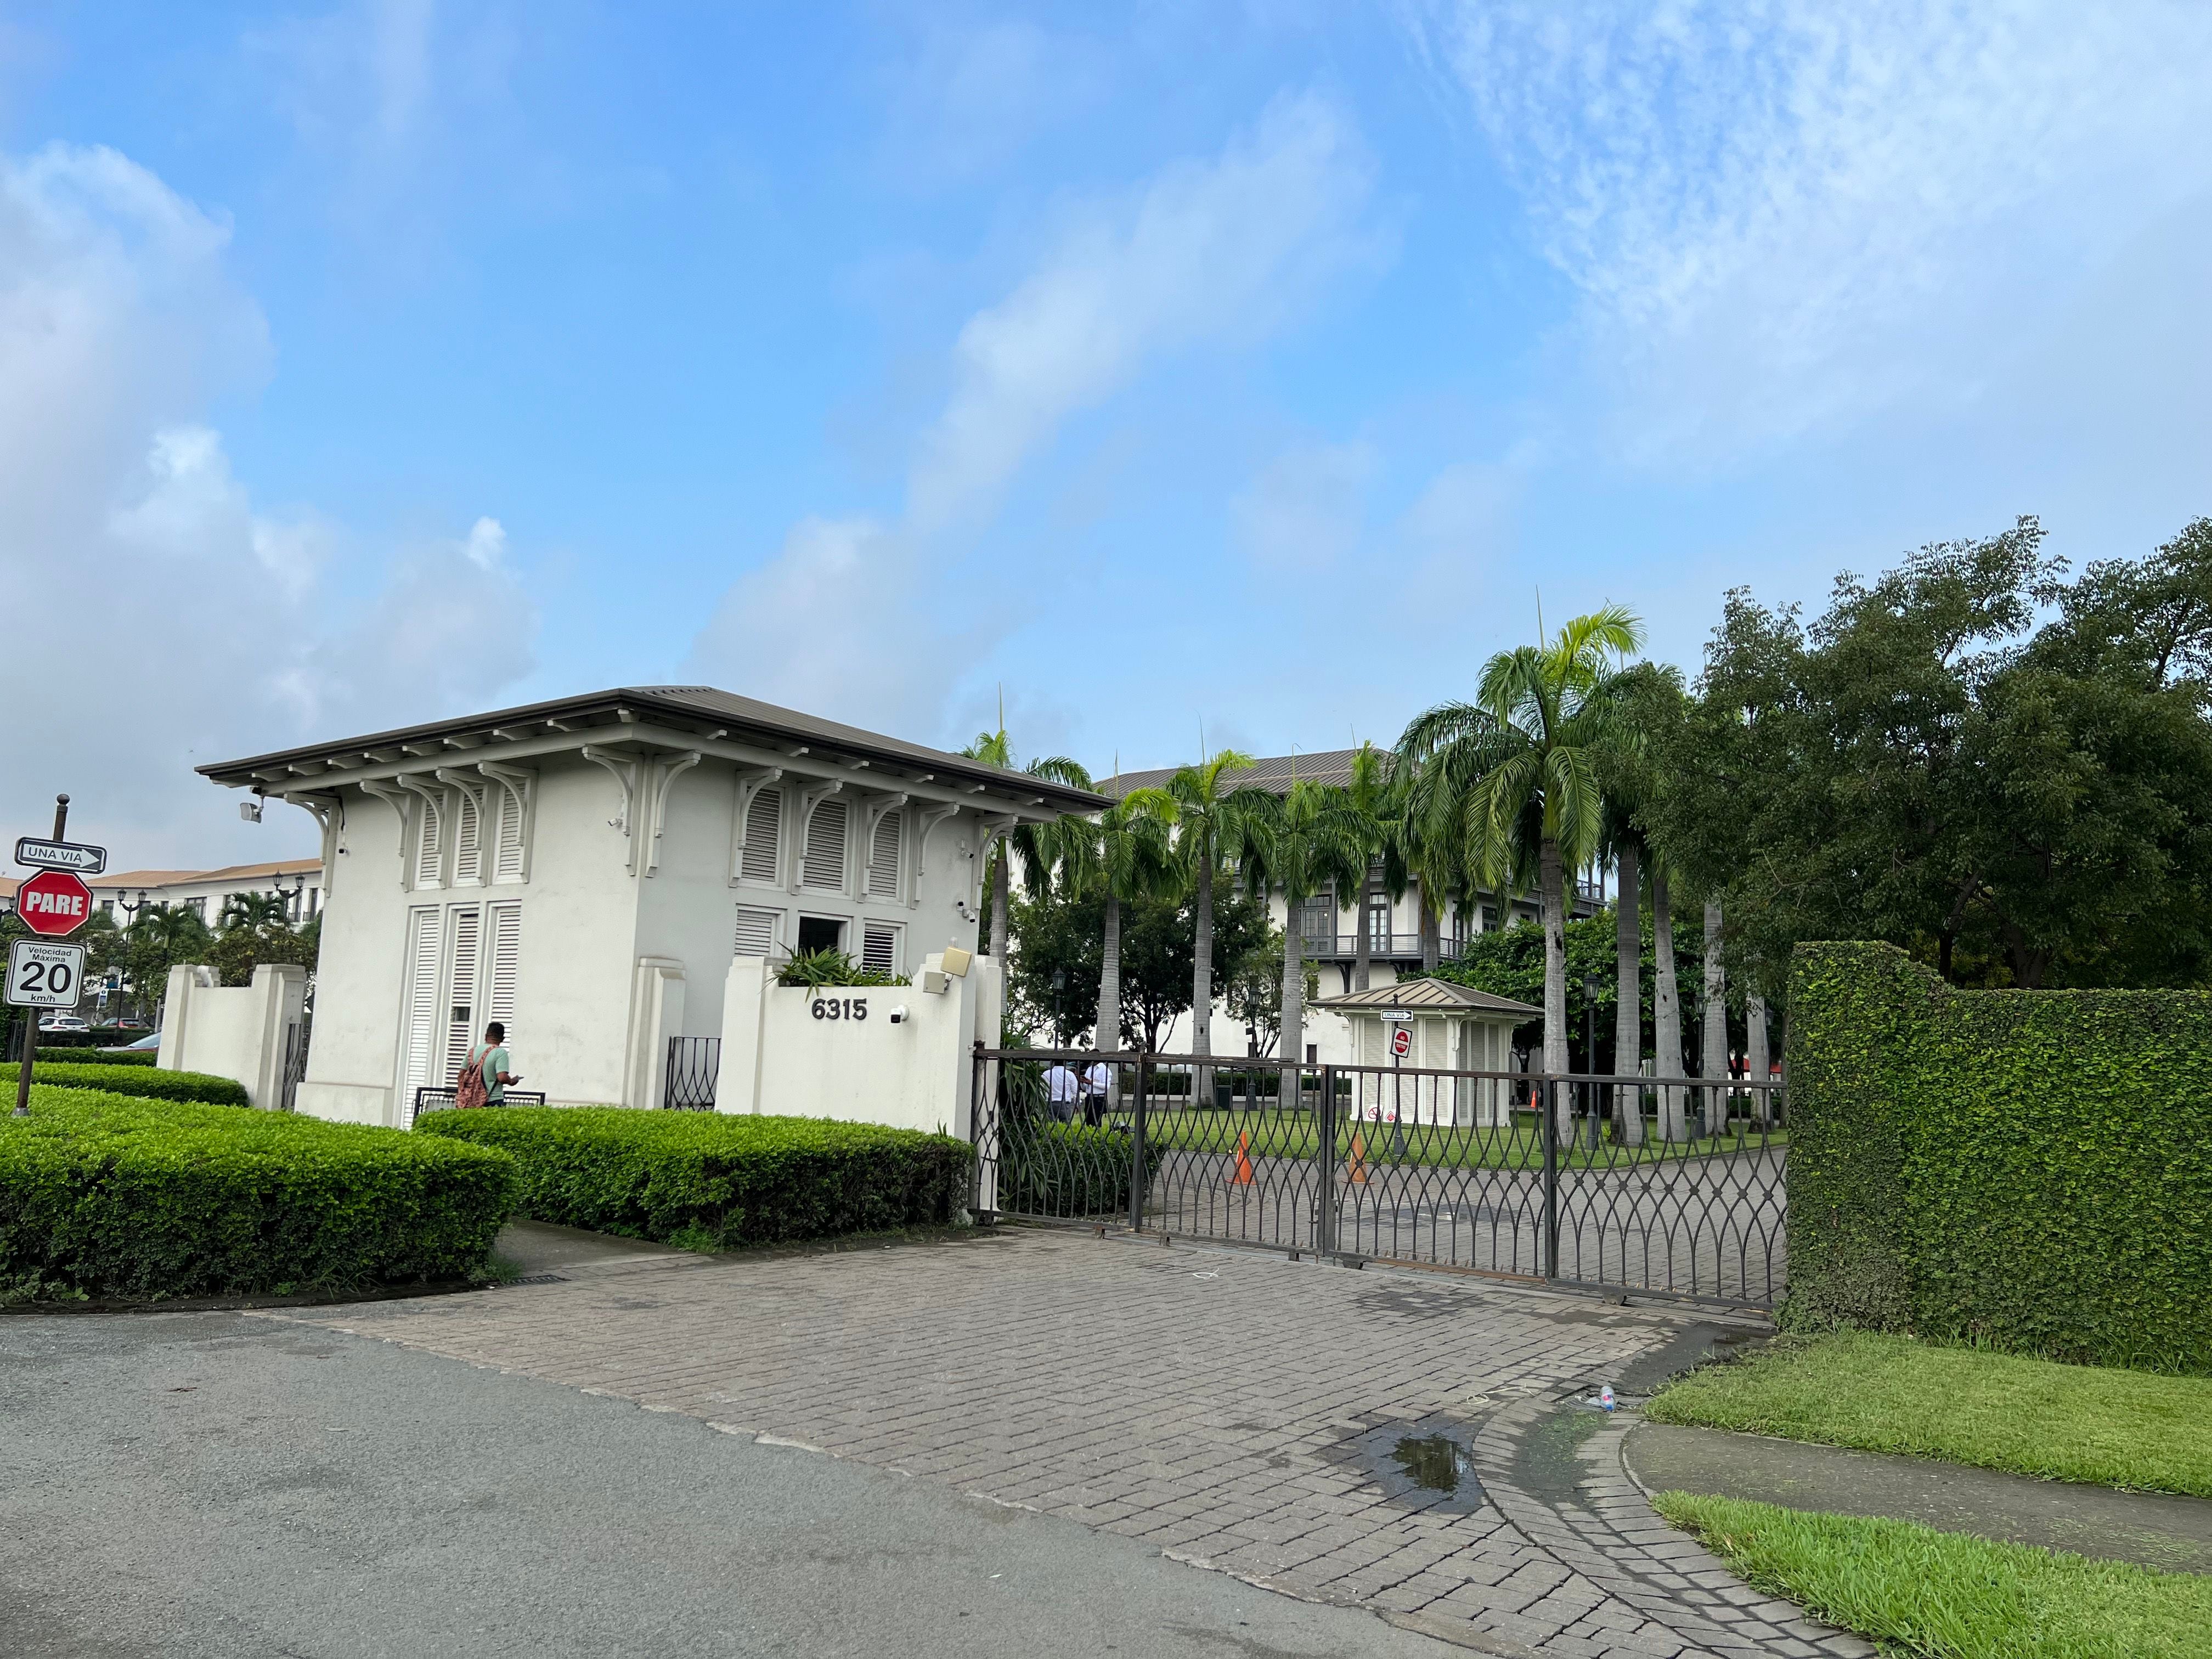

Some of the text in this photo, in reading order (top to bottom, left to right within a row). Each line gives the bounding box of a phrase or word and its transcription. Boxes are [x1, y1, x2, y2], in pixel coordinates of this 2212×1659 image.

[29, 847, 82, 862] UNA VIA
[26, 891, 83, 916] PARE
[29, 946, 72, 956] Velocidad
[32, 954, 65, 962] Máxima
[20, 961, 71, 994] 20
[31, 994, 55, 1003] km/h
[812, 998, 867, 1020] 6315
